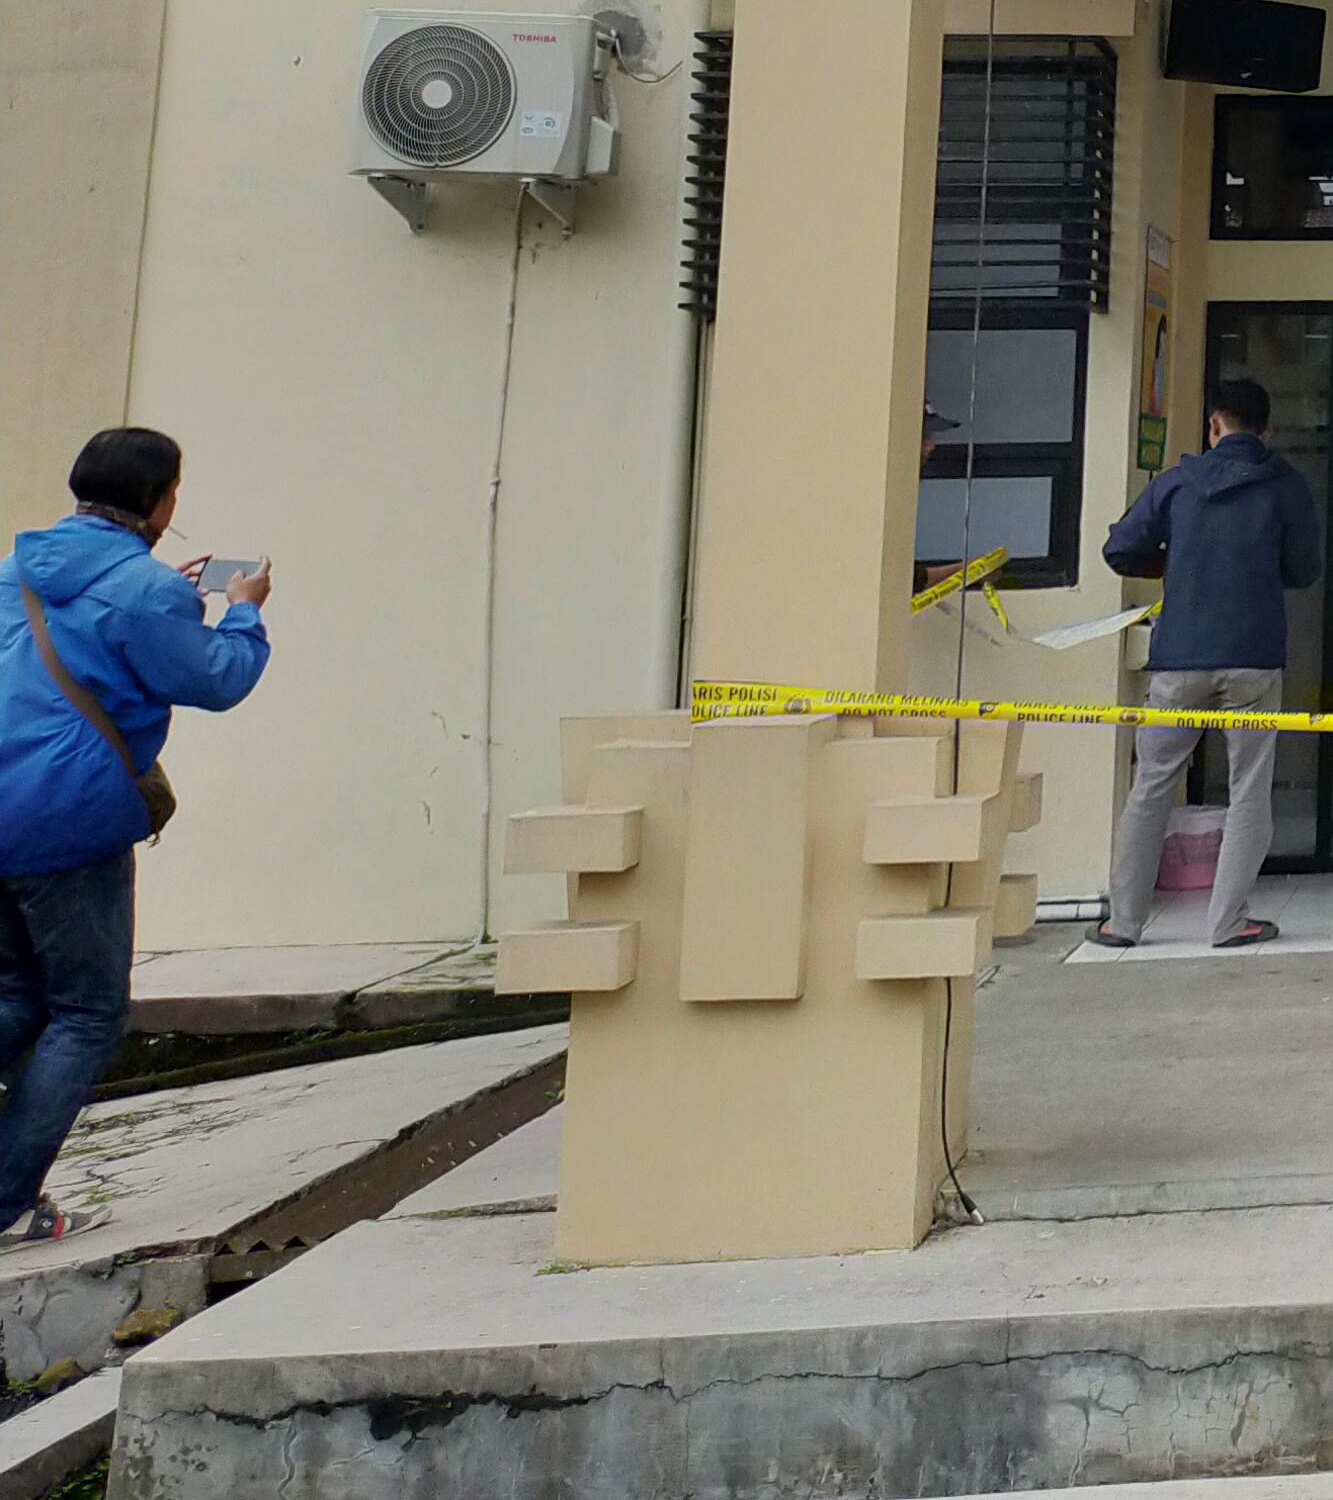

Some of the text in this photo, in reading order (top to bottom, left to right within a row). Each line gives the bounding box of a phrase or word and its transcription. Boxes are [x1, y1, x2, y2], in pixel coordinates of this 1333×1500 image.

[512, 33, 557, 43] TOSHIBA
[693, 686, 777, 701] RIS POLISI
[691, 704, 731, 718] OLICE
[1176, 717, 1278, 730] DO NOT CROSS
